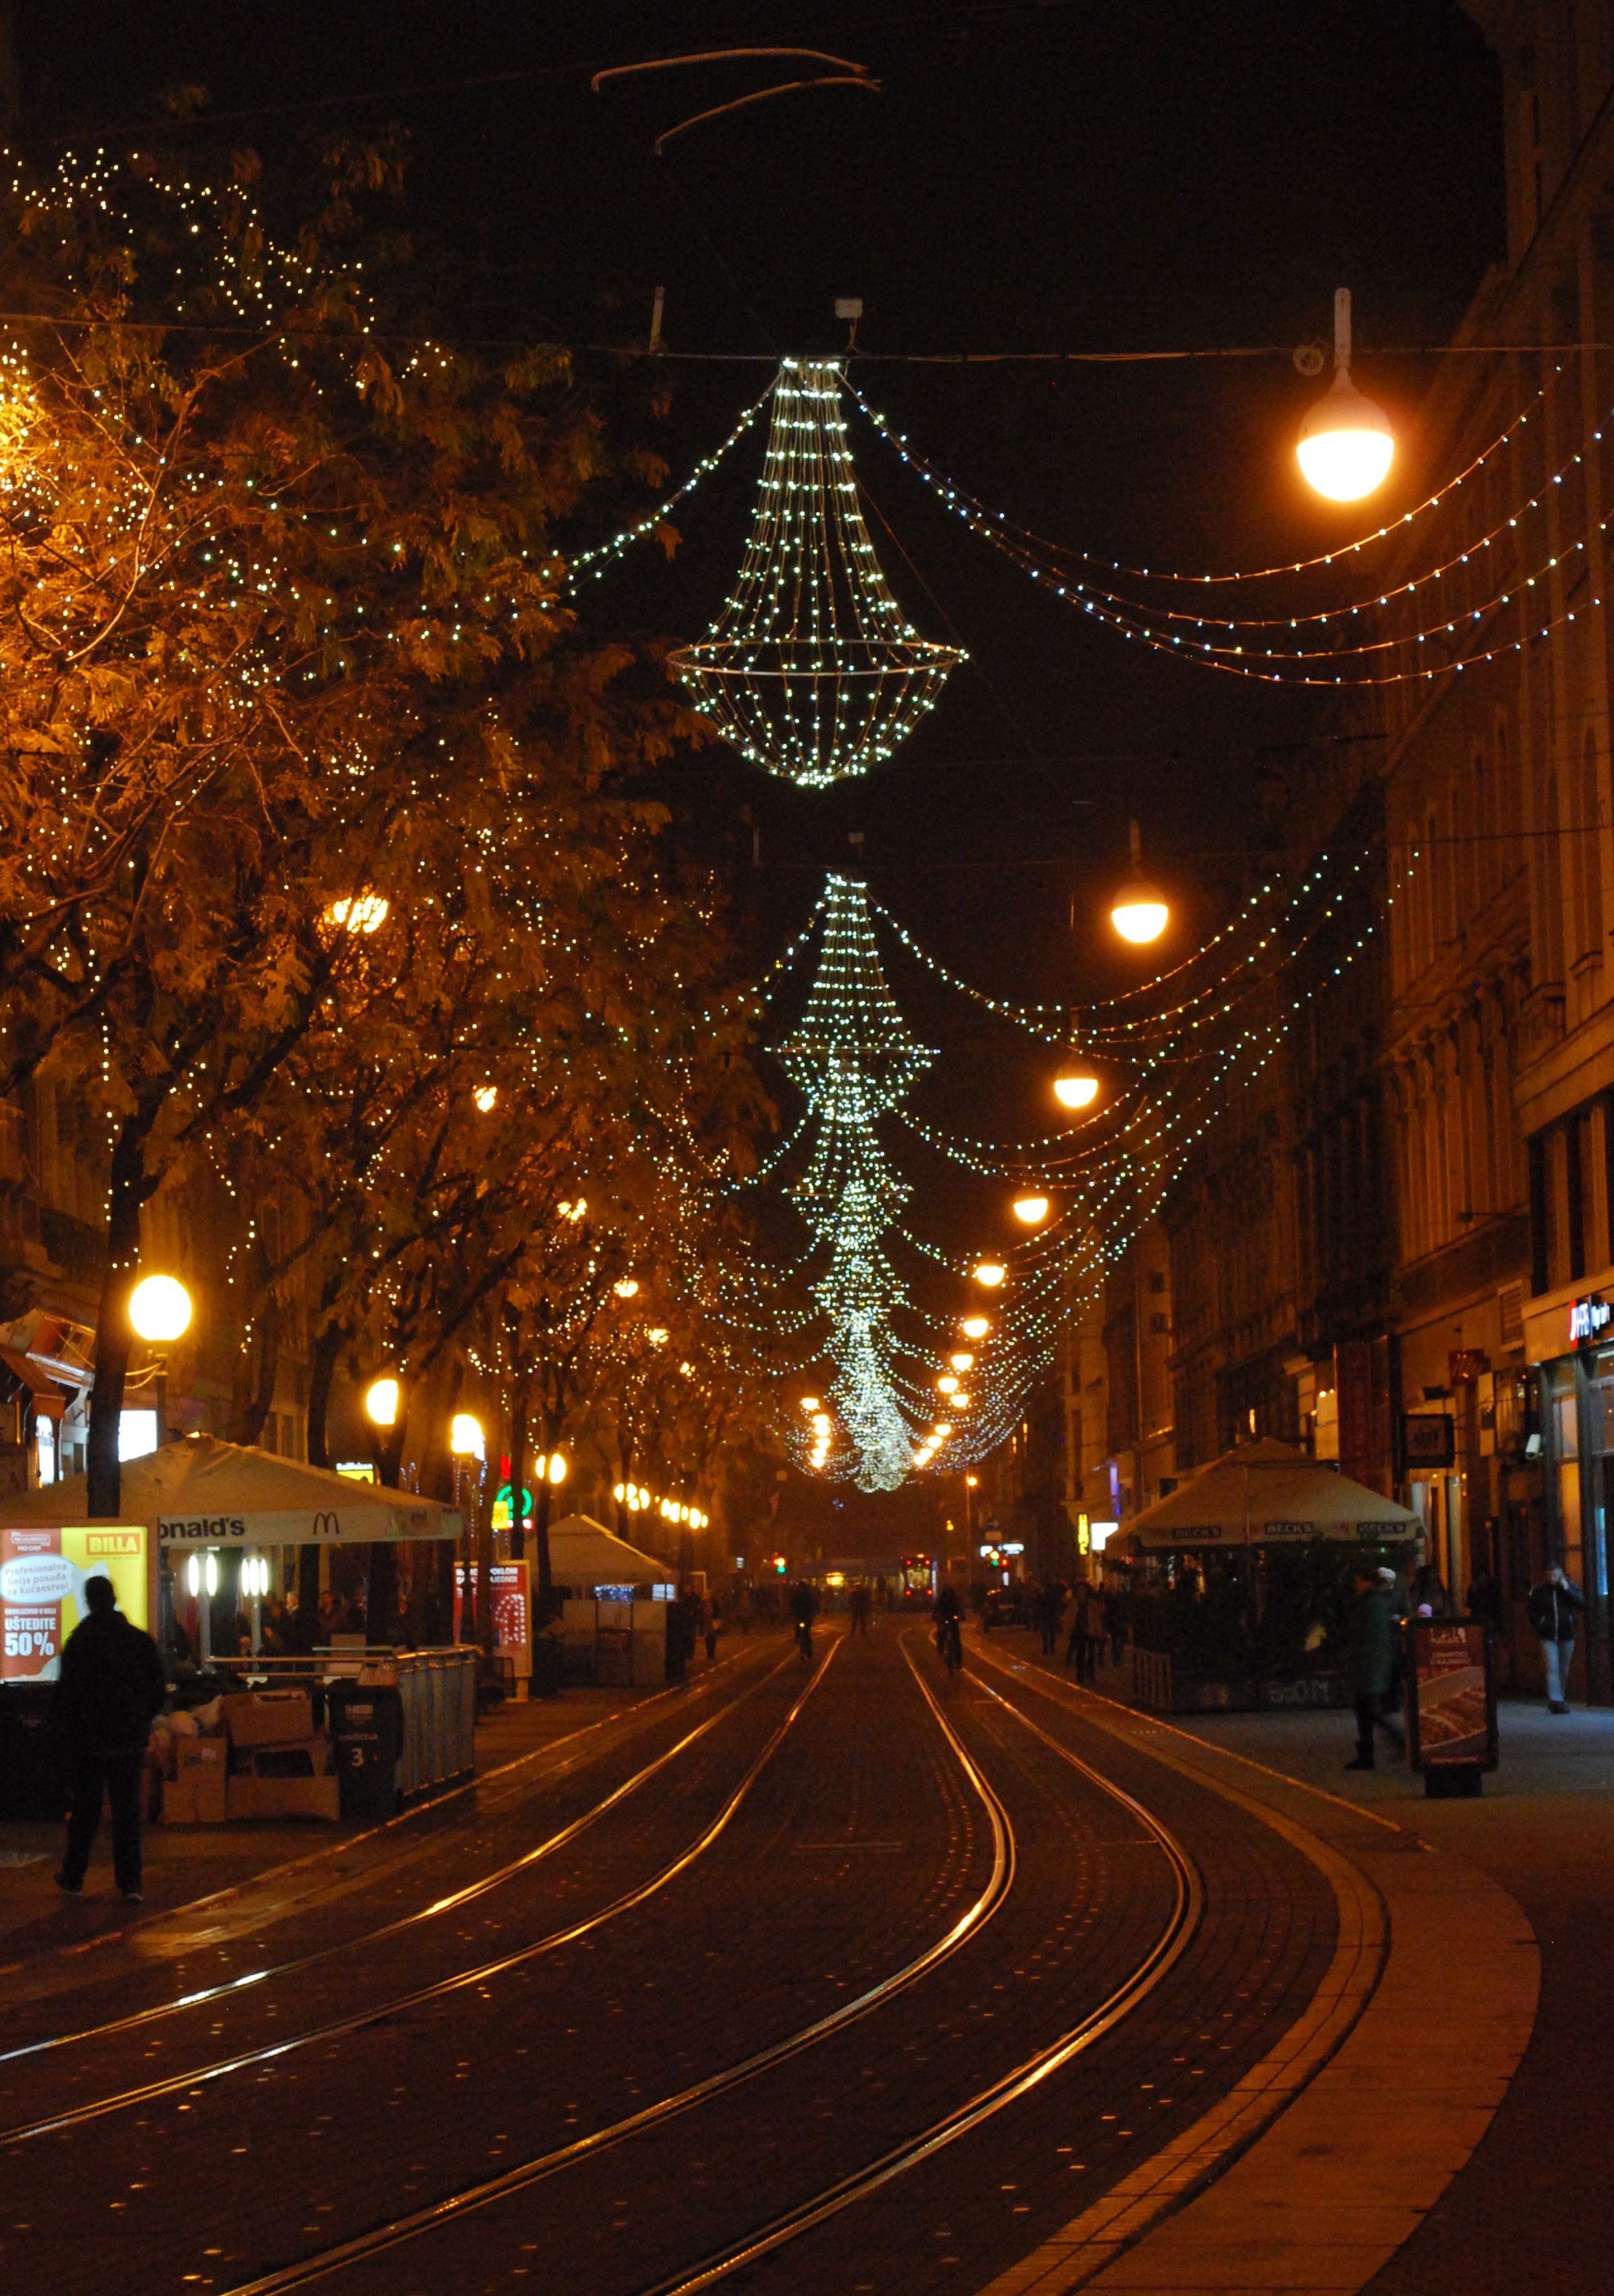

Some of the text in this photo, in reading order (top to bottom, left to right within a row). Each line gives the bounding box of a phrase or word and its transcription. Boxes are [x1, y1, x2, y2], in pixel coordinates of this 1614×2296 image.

[89, 1536, 137, 1553] BILLA
[5, 1563, 67, 1575] Profesionalna
[8, 1573, 66, 1586] linija posuđa
[20, 1582, 68, 1594] kućanstvo!
[5, 1616, 56, 1631] UŠTEDITE
[5, 1631, 55, 1657] 50%
[352, 1748, 364, 1767] 3
